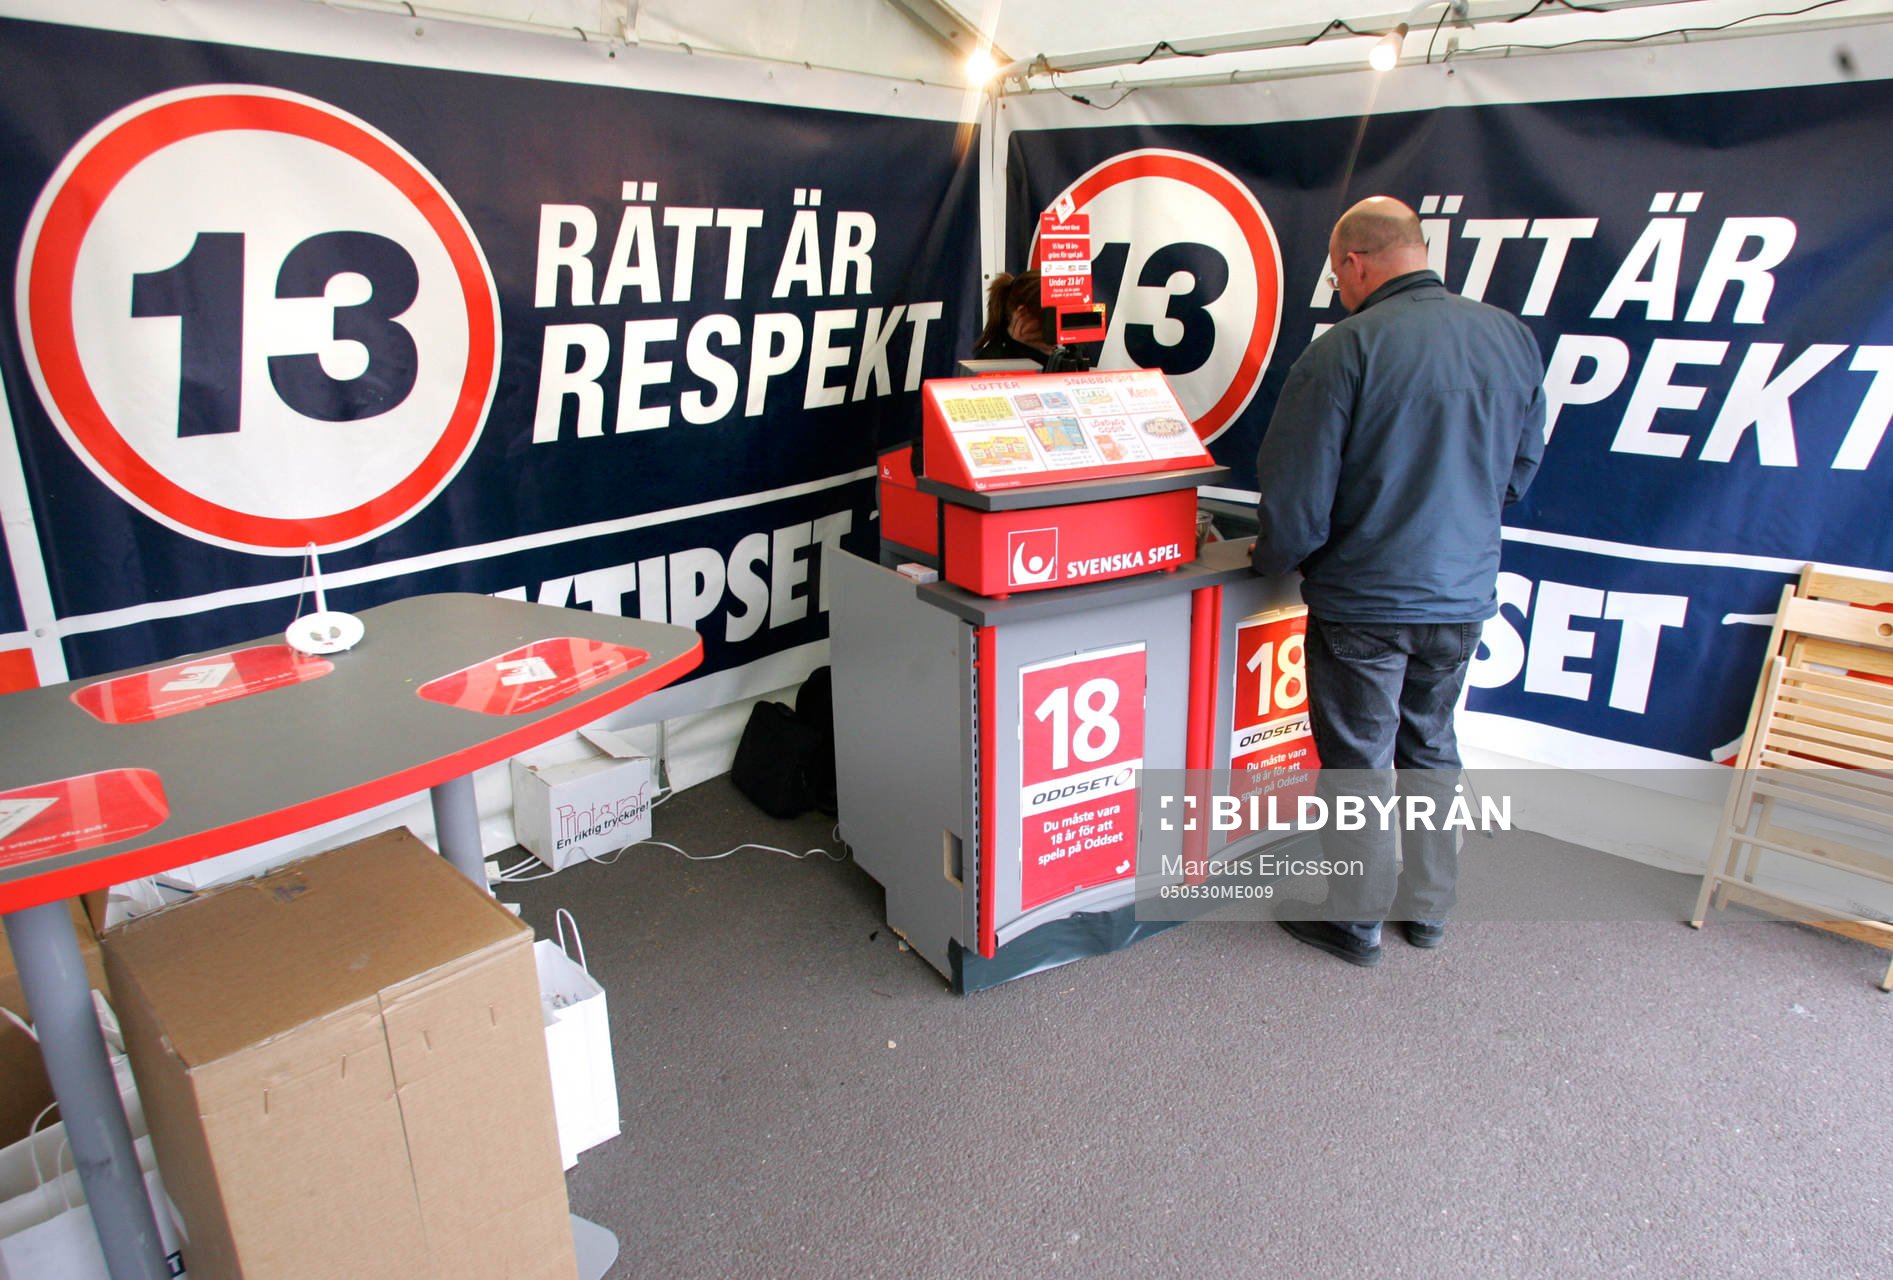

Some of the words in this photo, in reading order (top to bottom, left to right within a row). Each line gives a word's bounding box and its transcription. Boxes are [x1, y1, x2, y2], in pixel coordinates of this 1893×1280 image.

[534, 181, 764, 308] RÄTT
[771, 188, 877, 298] ÄR
[1309, 195, 1599, 316] ÄTT
[1589, 191, 1797, 324] ÄR
[1048, 278, 1066, 287] Under
[1090, 241, 1229, 375] 13
[131, 230, 420, 438] 13
[532, 301, 943, 444] RESPEKT
[970, 381, 1021, 391] LOTTER
[1067, 551, 1144, 578] SVENSKA
[1148, 543, 1181, 564] SPEL
[1246, 634, 1308, 717] 18
[1034, 677, 1121, 771] 18
[1239, 721, 1303, 748] ODDSET
[1246, 760, 1259, 772] Du
[1260, 753, 1286, 770] måste
[1288, 748, 1307, 759] vara
[1251, 773, 1261, 784] 18
[1262, 769, 1272, 780] år
[1273, 764, 1287, 778] för
[1288, 762, 1301, 773] att
[1032, 775, 1114, 805] ODDSET
[1240, 786, 1262, 802] spela
[1263, 782, 1275, 795] på
[1276, 772, 1308, 789] Oddset
[556, 839, 572, 850] En
[574, 824, 602, 844] riktig
[604, 801, 649, 828] tryckare!
[1043, 821, 1059, 833] Du
[1062, 811, 1095, 830] måste
[1097, 804, 1121, 818] vara
[1051, 834, 1062, 846] 18
[1065, 828, 1076, 842] år
[1078, 823, 1095, 838] för
[1097, 819, 1113, 833] att
[1038, 848, 1066, 866] spela
[1068, 843, 1082, 858] på
[1084, 832, 1124, 850] Oddset
